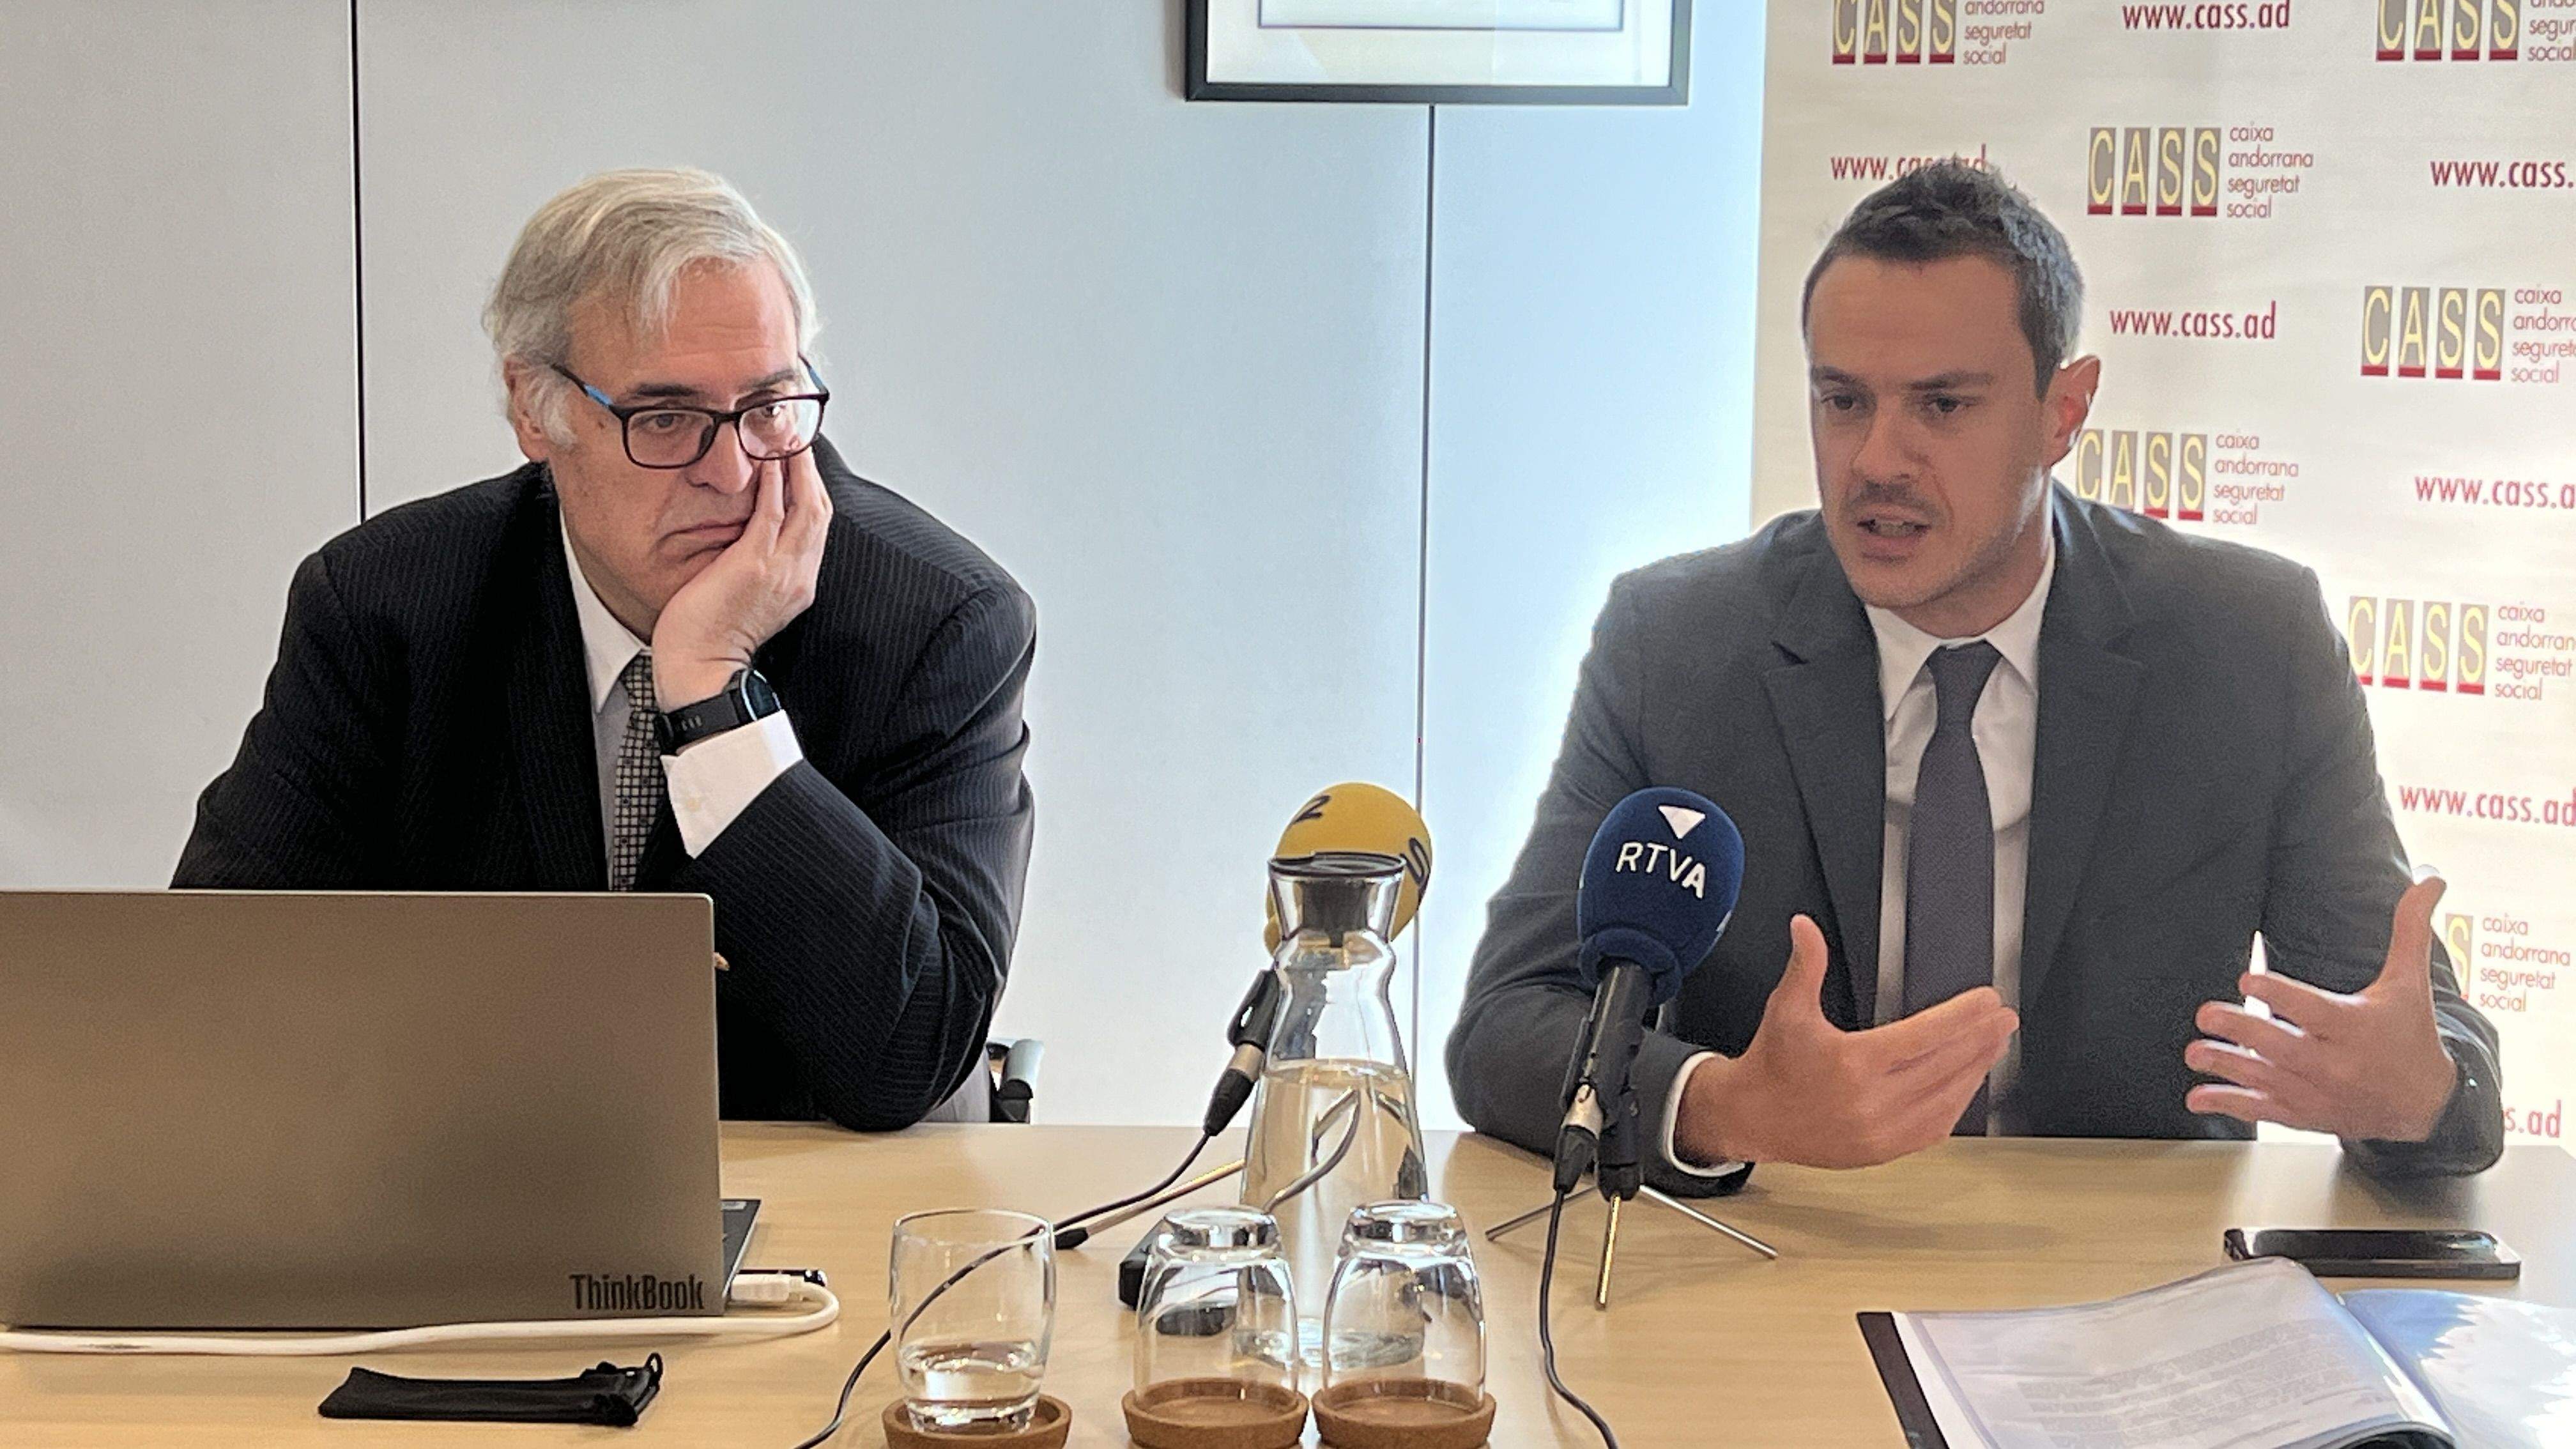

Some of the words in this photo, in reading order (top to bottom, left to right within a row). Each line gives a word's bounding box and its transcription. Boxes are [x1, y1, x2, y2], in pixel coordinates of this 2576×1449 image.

[2122, 0, 2290, 29] www.cass.ad
[2380, 0, 2517, 49] CASS
[1835, 0, 1954, 54] CASS
[1964, 22, 2032, 46] seguretat
[1963, 42, 2007, 65] social
[2230, 121, 2274, 142] caixa
[2089, 130, 2217, 205] CASS
[2228, 144, 2314, 167] andorrana
[2228, 174, 2300, 199] seguretat
[2227, 195, 2271, 218] social
[2515, 284, 2561, 304] caixa
[2110, 300, 2276, 339] www.cass.ad
[2365, 288, 2501, 369] CASS
[2512, 339, 2576, 364] seguret
[2511, 360, 2559, 383] social
[2216, 427, 2259, 449] caixa
[2078, 431, 2204, 510] CASS
[2215, 453, 2299, 477] andorrana
[2214, 482, 2285, 505] seguretat
[2414, 476, 2575, 509] www.cass.a
[2213, 503, 2257, 524] social
[2498, 601, 2545, 623] caixa
[2349, 599, 2484, 682] CASS
[2496, 657, 2573, 680] seguretat
[2495, 677, 2543, 700] social
[2400, 785, 2576, 827] www.cass.ad
[1615, 842, 1706, 899] RTVA
[2483, 913, 2528, 935] caixa
[2481, 937, 2570, 966] andorrana
[2480, 966, 2556, 990] seguretat
[2479, 991, 2526, 1012] social
[569, 1273, 705, 1310] ThinkBook
